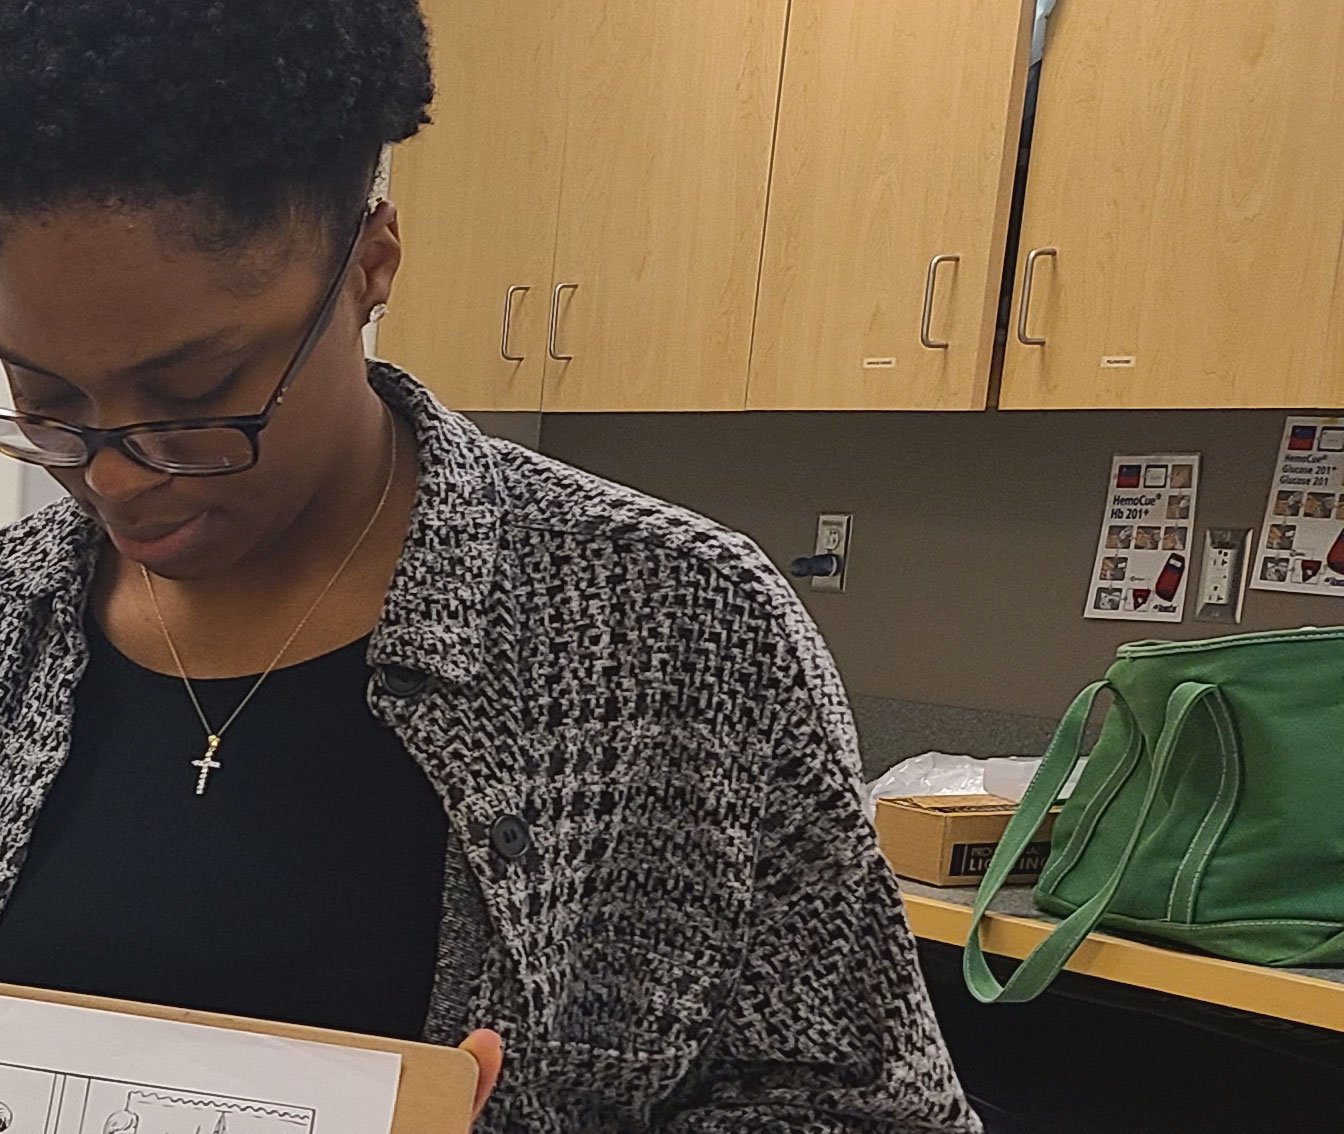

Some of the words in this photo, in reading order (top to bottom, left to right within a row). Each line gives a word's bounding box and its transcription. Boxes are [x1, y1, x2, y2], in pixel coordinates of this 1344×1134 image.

[1282, 464, 1313, 475] Glucose
[1279, 475, 1311, 486] Glucose
[1313, 477, 1329, 486] 201
[1110, 508, 1124, 519] Hb
